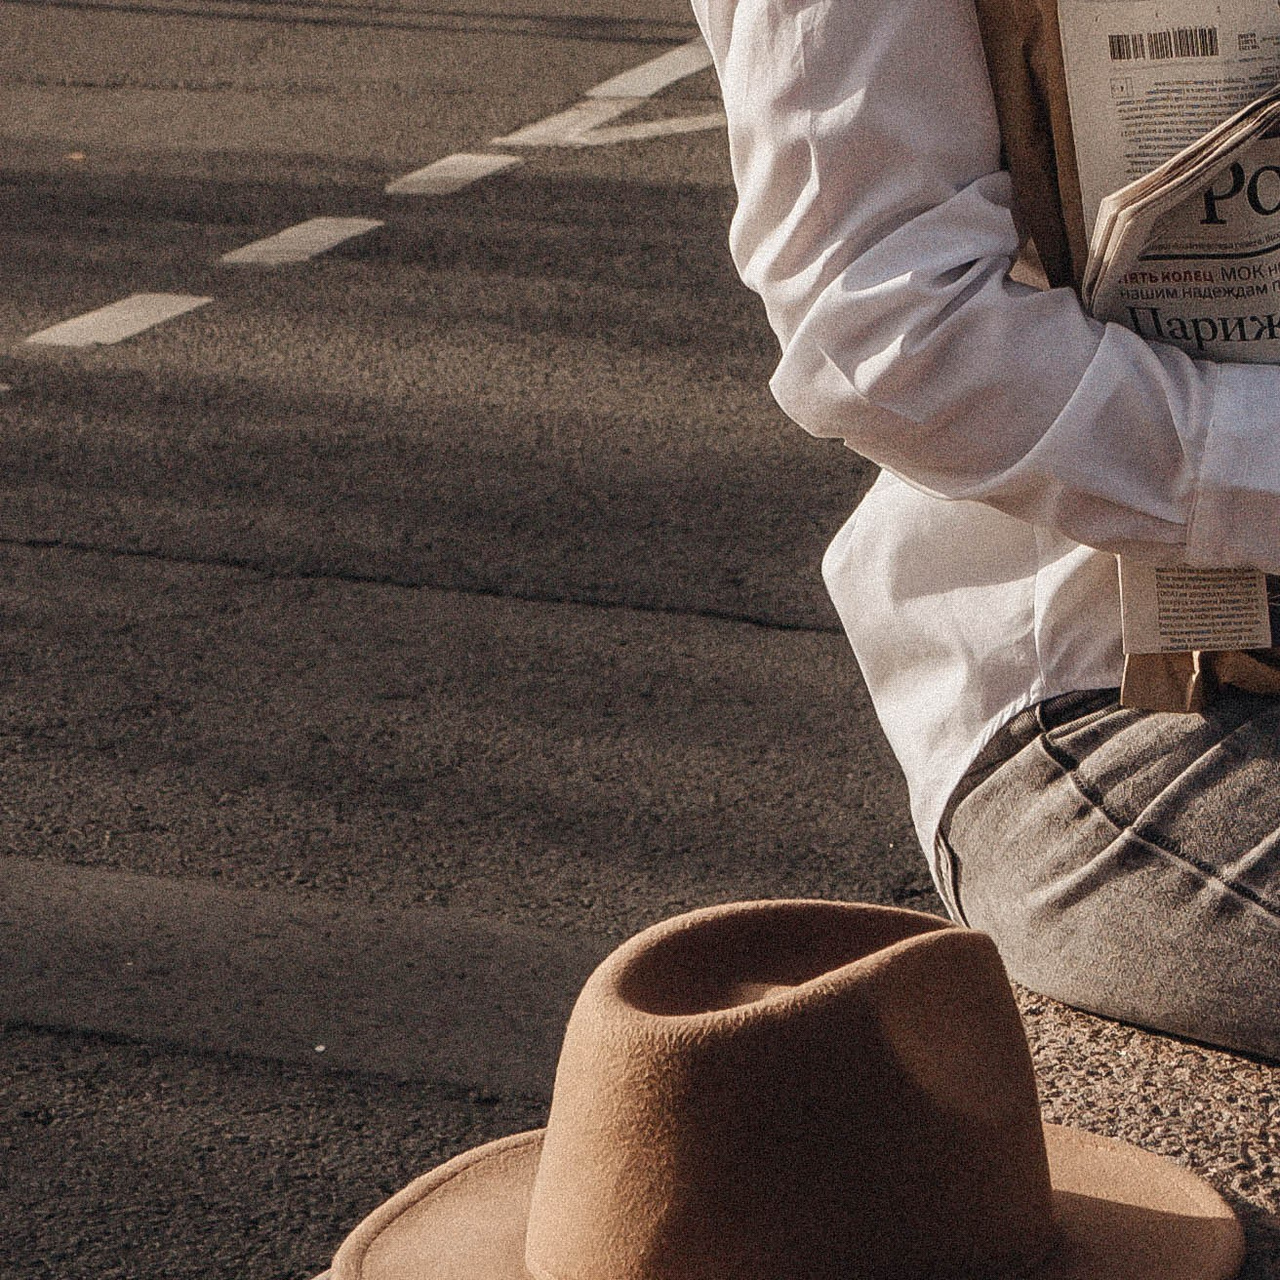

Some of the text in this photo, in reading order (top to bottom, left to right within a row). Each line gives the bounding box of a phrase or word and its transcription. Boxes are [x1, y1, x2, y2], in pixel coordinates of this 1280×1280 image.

[1220, 265, 1266, 282] МОК
[1119, 287, 1179, 300] нашим
[1182, 283, 1268, 300] надеждам
